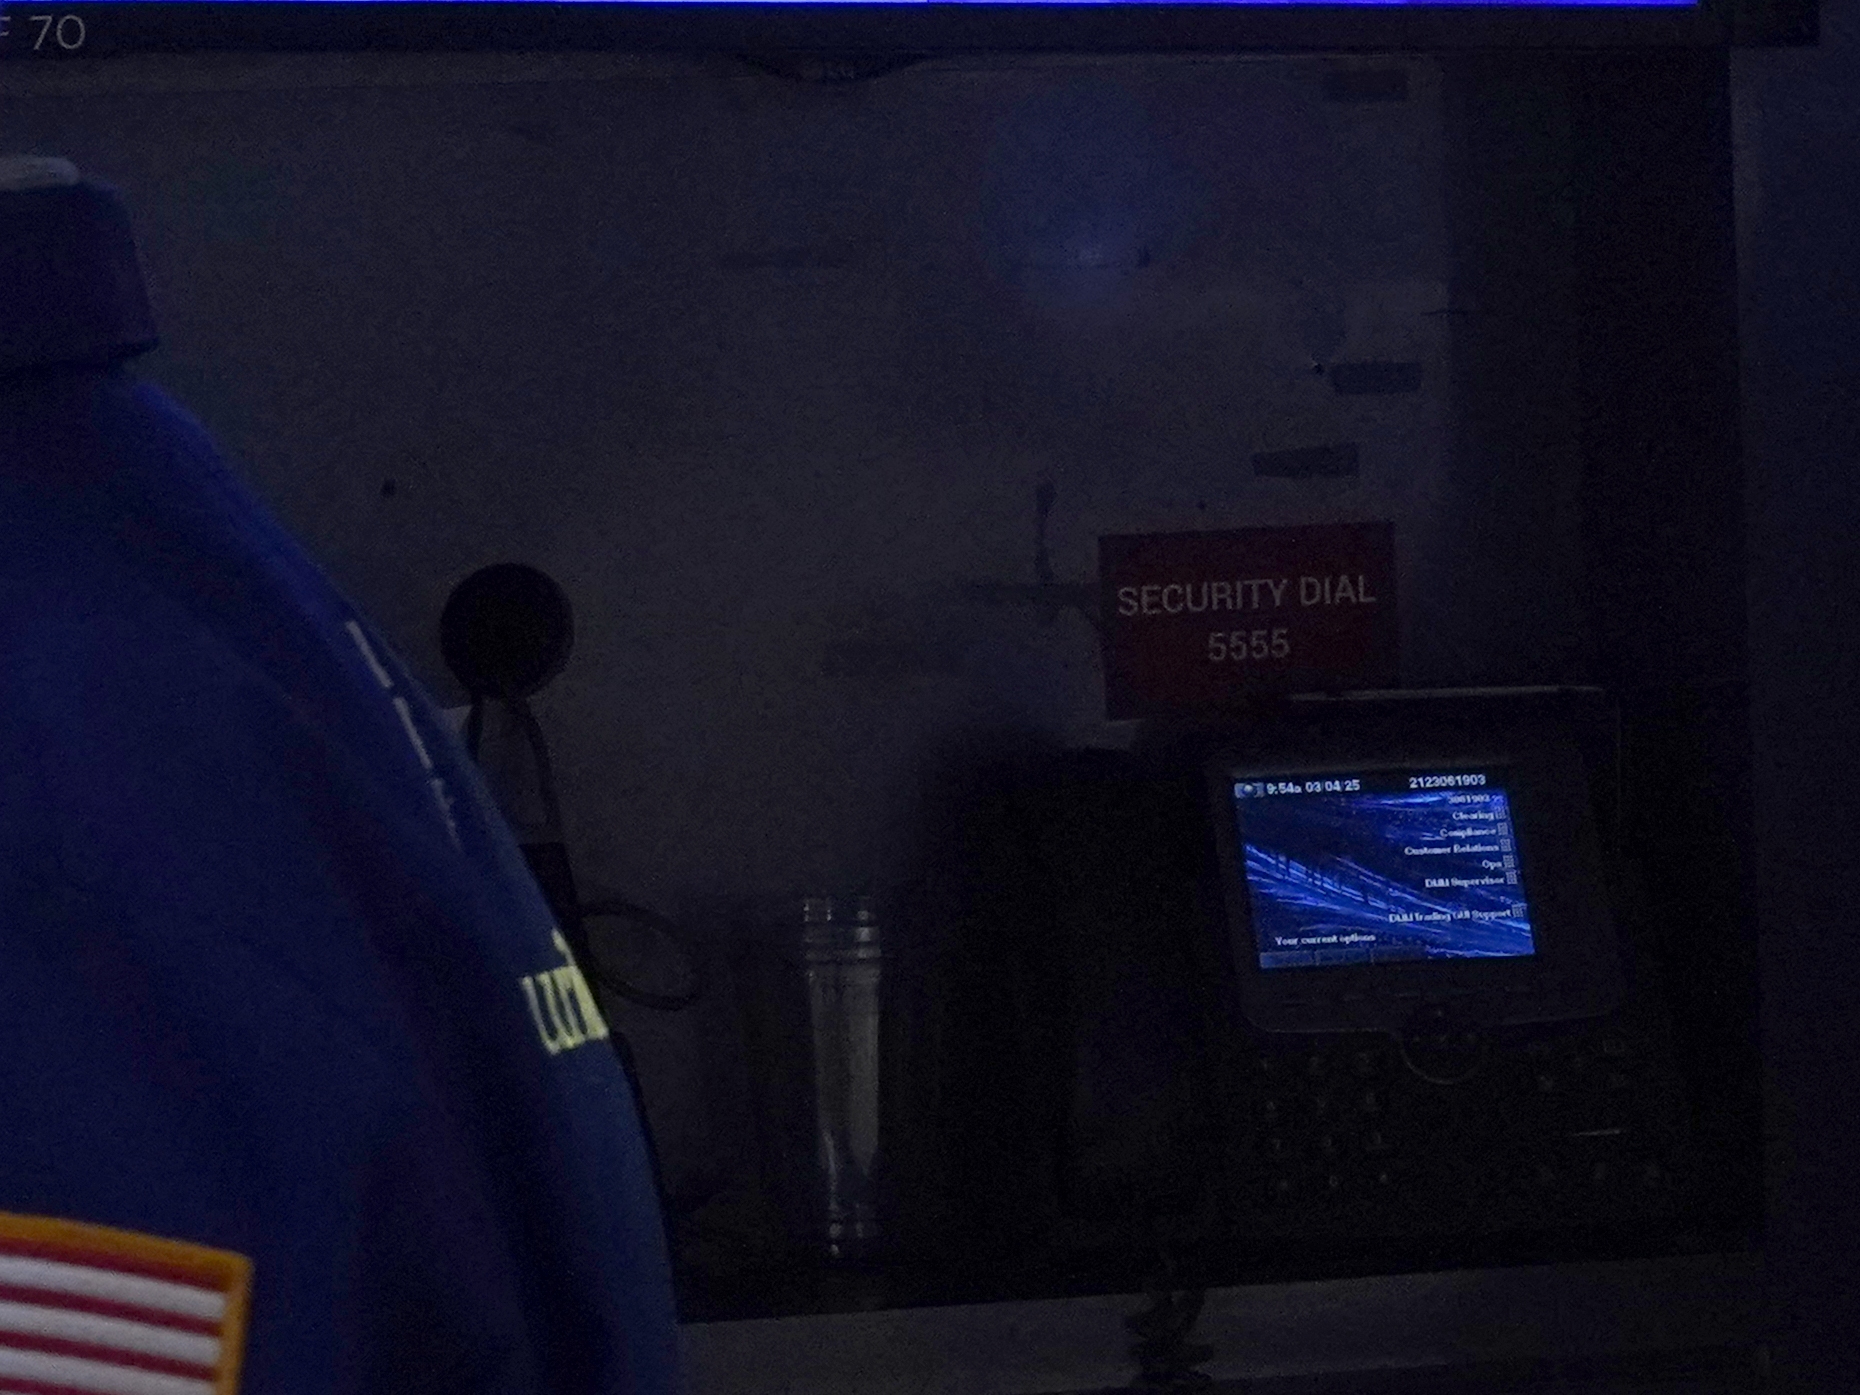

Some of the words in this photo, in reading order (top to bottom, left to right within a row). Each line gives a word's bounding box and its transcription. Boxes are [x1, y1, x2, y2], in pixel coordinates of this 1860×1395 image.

[29, 14, 87, 51] 70
[1117, 578, 1289, 616] SECURITY
[1300, 574, 1377, 606] DIAL
[1207, 627, 1290, 661] 5555
